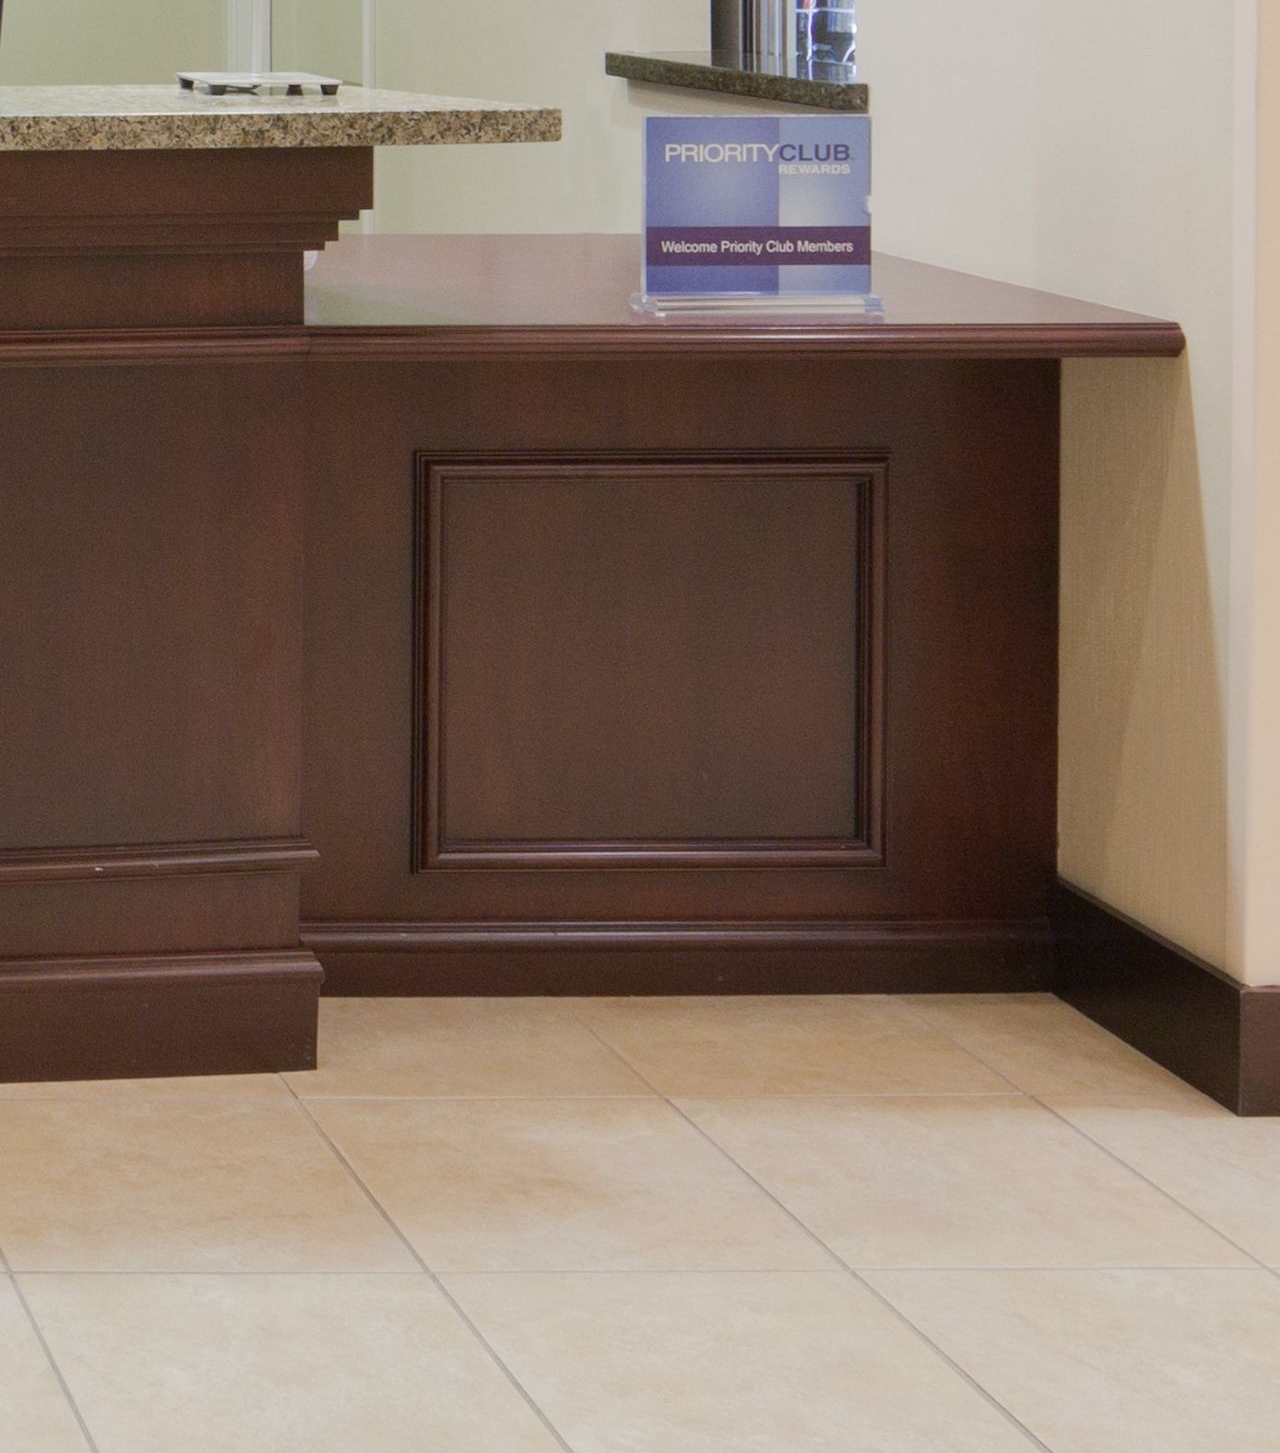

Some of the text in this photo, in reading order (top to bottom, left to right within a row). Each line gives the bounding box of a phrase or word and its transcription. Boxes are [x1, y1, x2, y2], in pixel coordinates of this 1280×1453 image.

[778, 164, 851, 175] REWARDS
[661, 240, 854, 256] Welcome Priority Club Members
